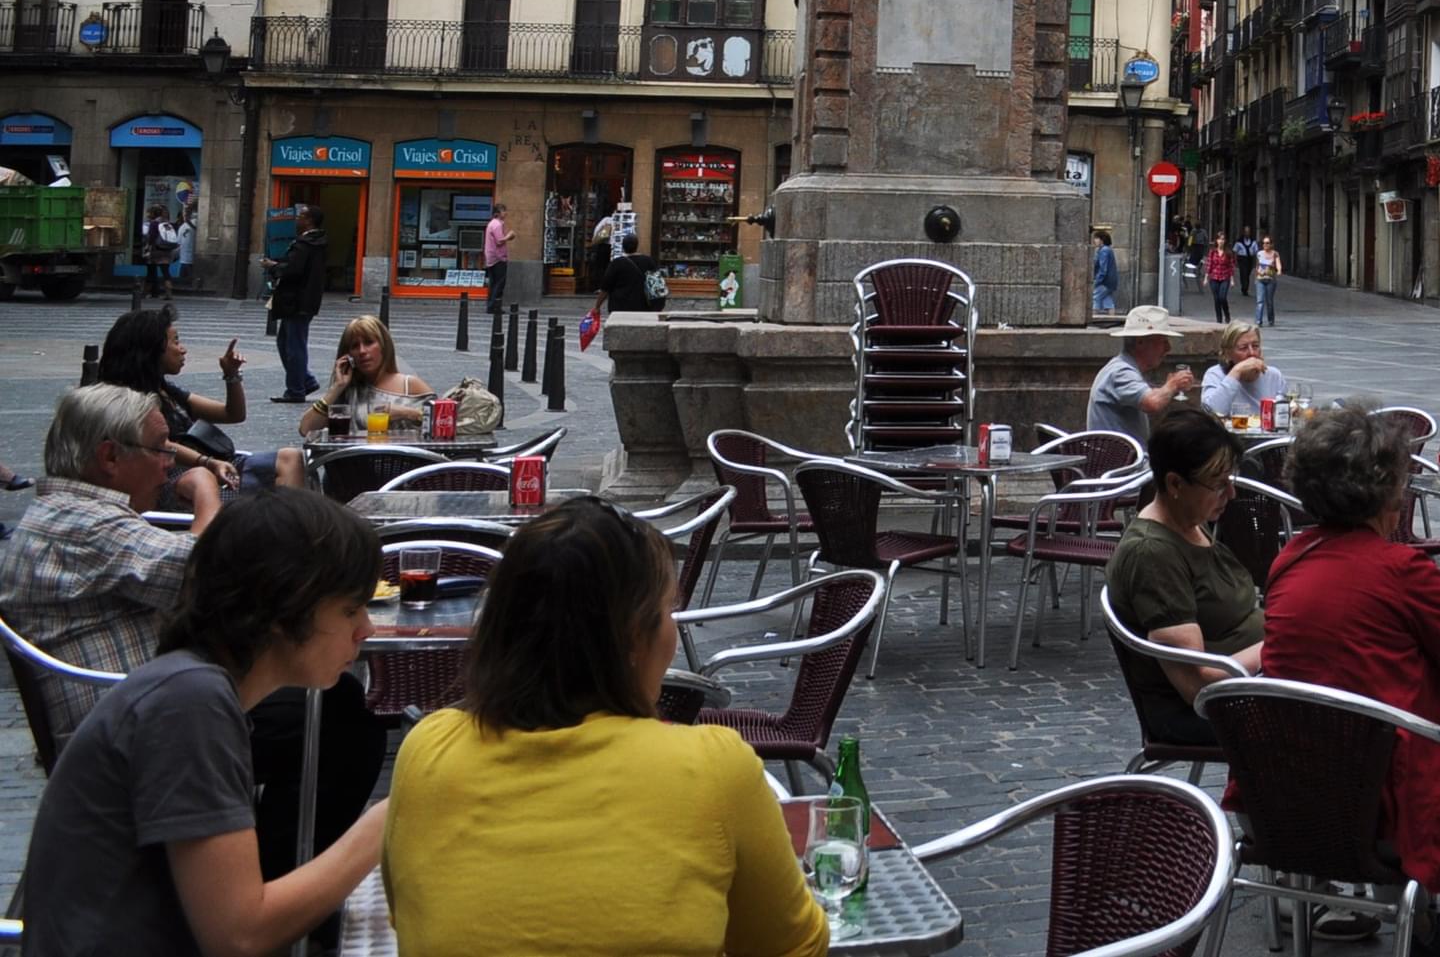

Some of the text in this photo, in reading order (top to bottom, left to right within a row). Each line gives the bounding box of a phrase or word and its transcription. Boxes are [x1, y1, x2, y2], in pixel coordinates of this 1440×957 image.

[281, 146, 362, 163] Viajes Crisol
[403, 148, 488, 165] Viajes Crisol
